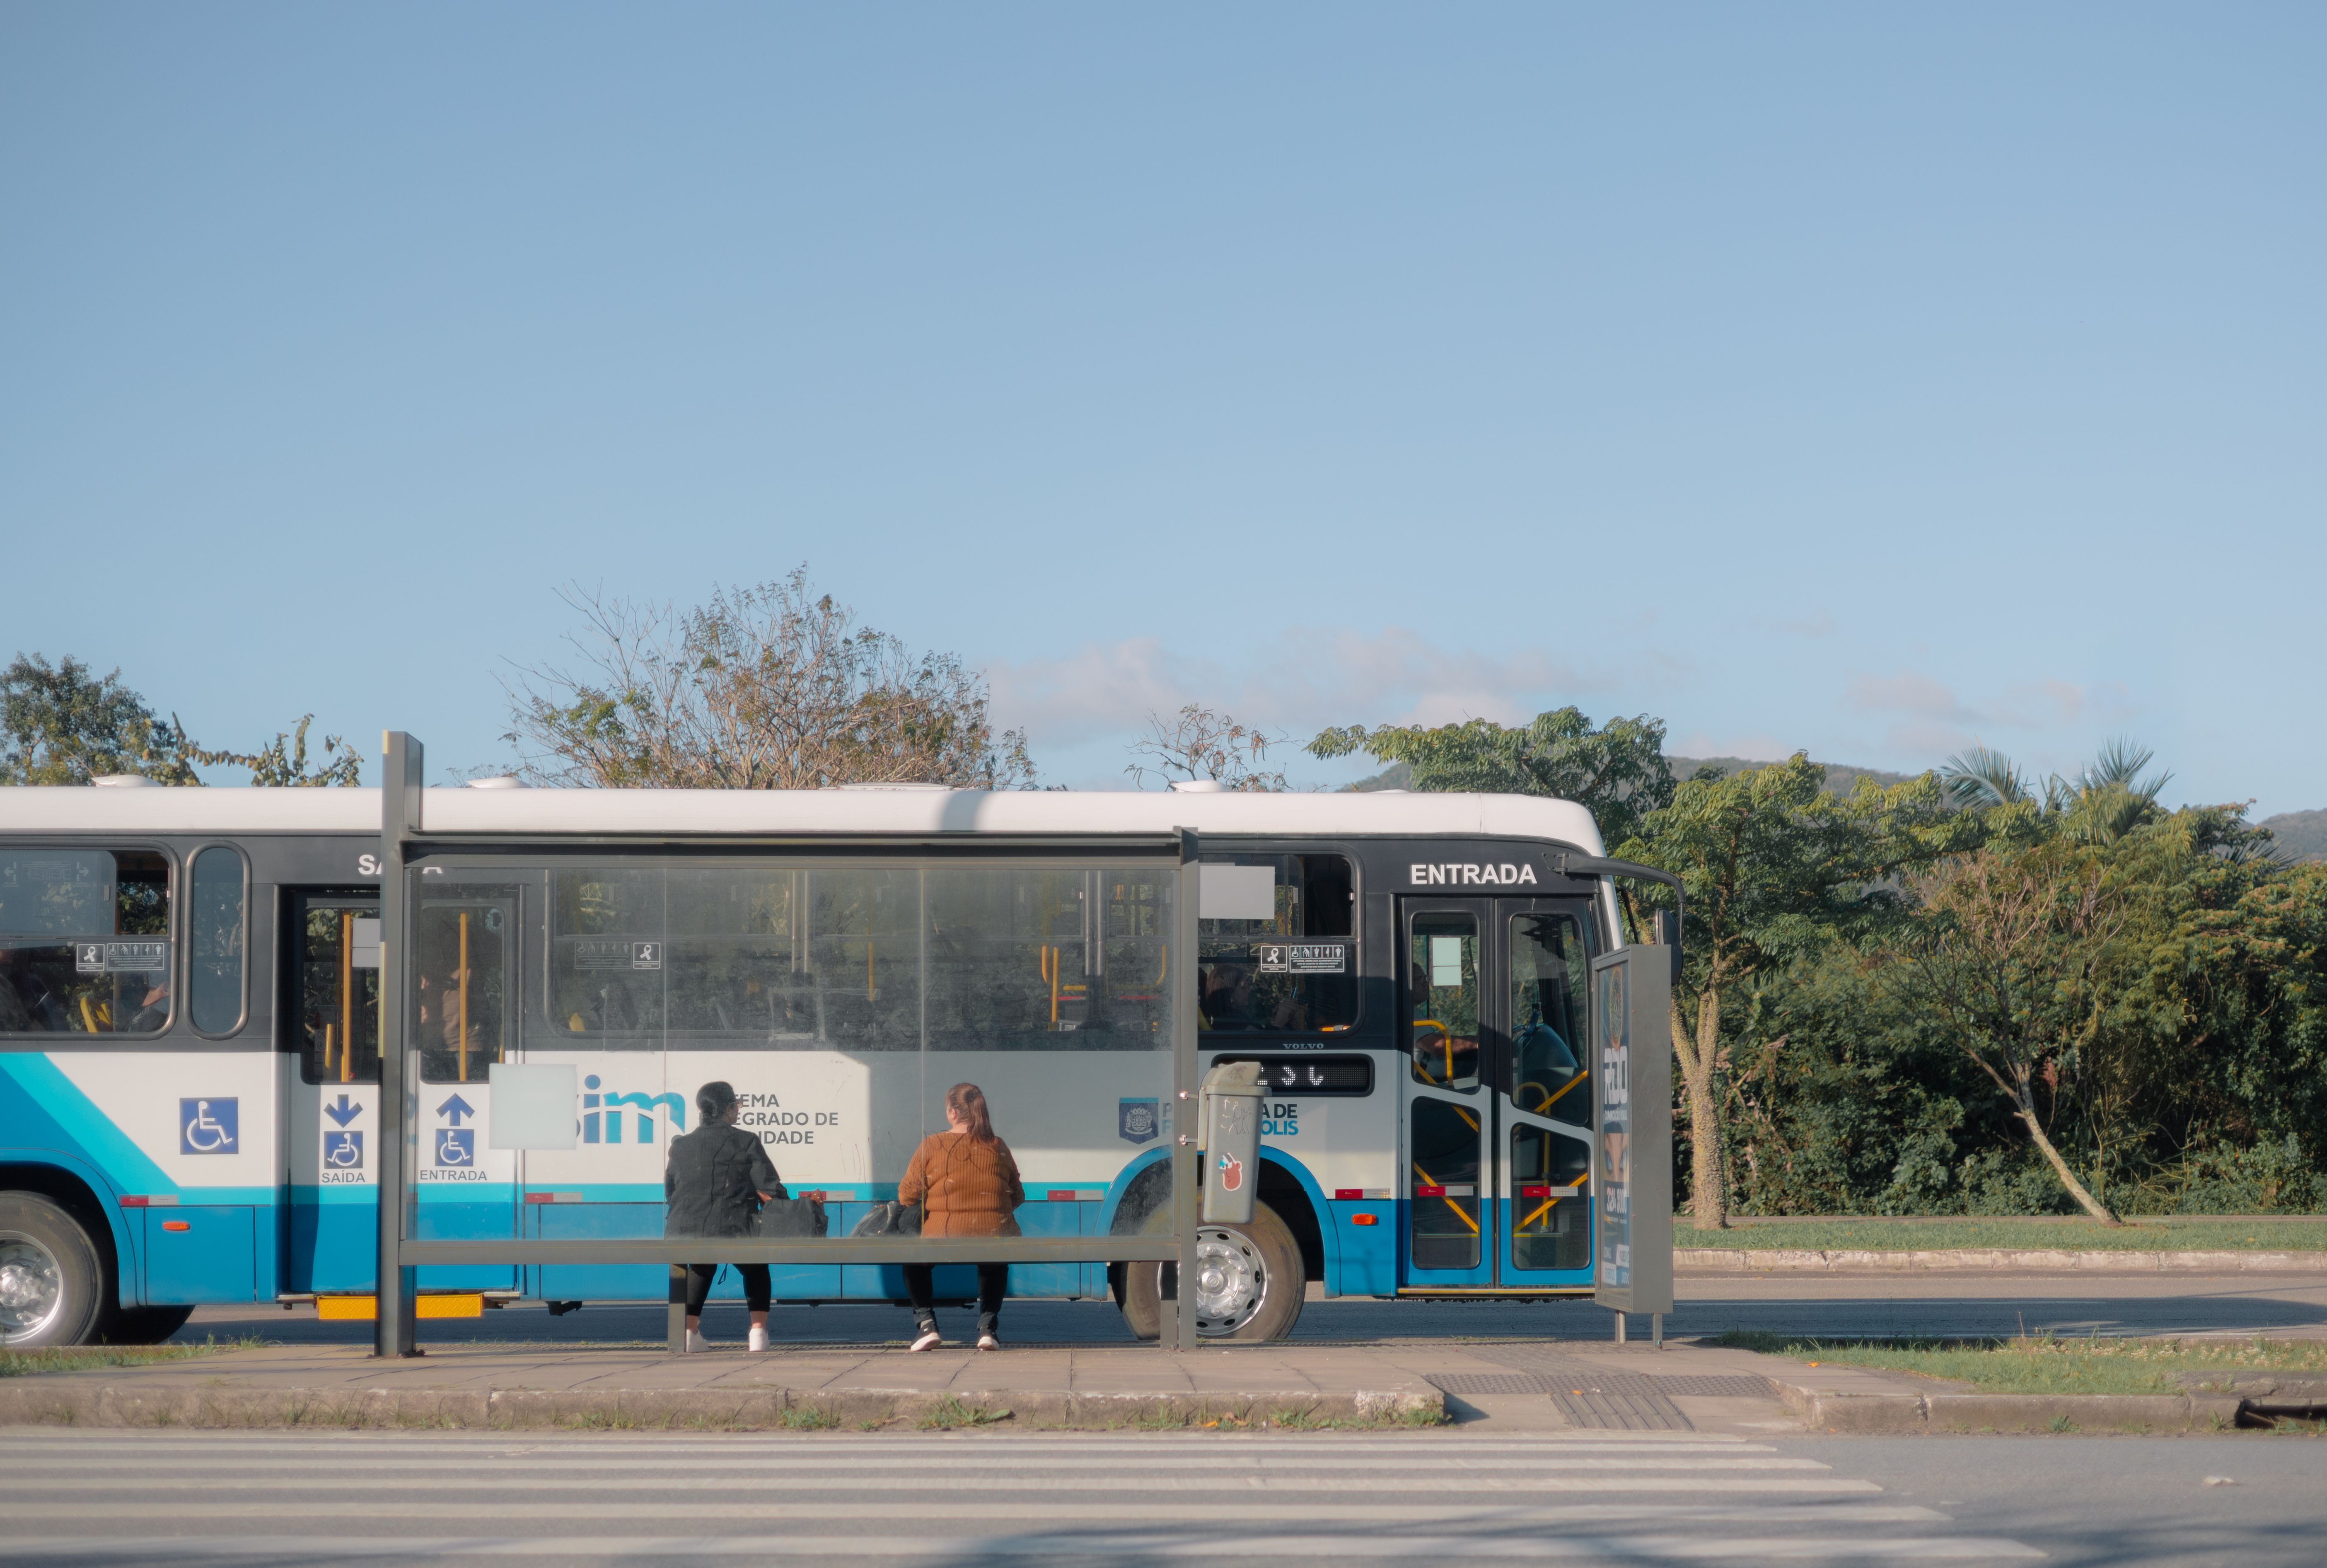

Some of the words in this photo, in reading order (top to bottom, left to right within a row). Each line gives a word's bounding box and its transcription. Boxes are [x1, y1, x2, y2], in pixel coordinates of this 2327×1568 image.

[1411, 864, 1537, 884] ENTRADA
[576, 1074, 686, 1144] im
[1274, 1104, 1298, 1119] DE
[815, 1112, 838, 1126] DE
[1261, 1120, 1299, 1136] OLIS
[321, 1169, 365, 1183] SAÍDA
[420, 1170, 488, 1181] ENTRADA
